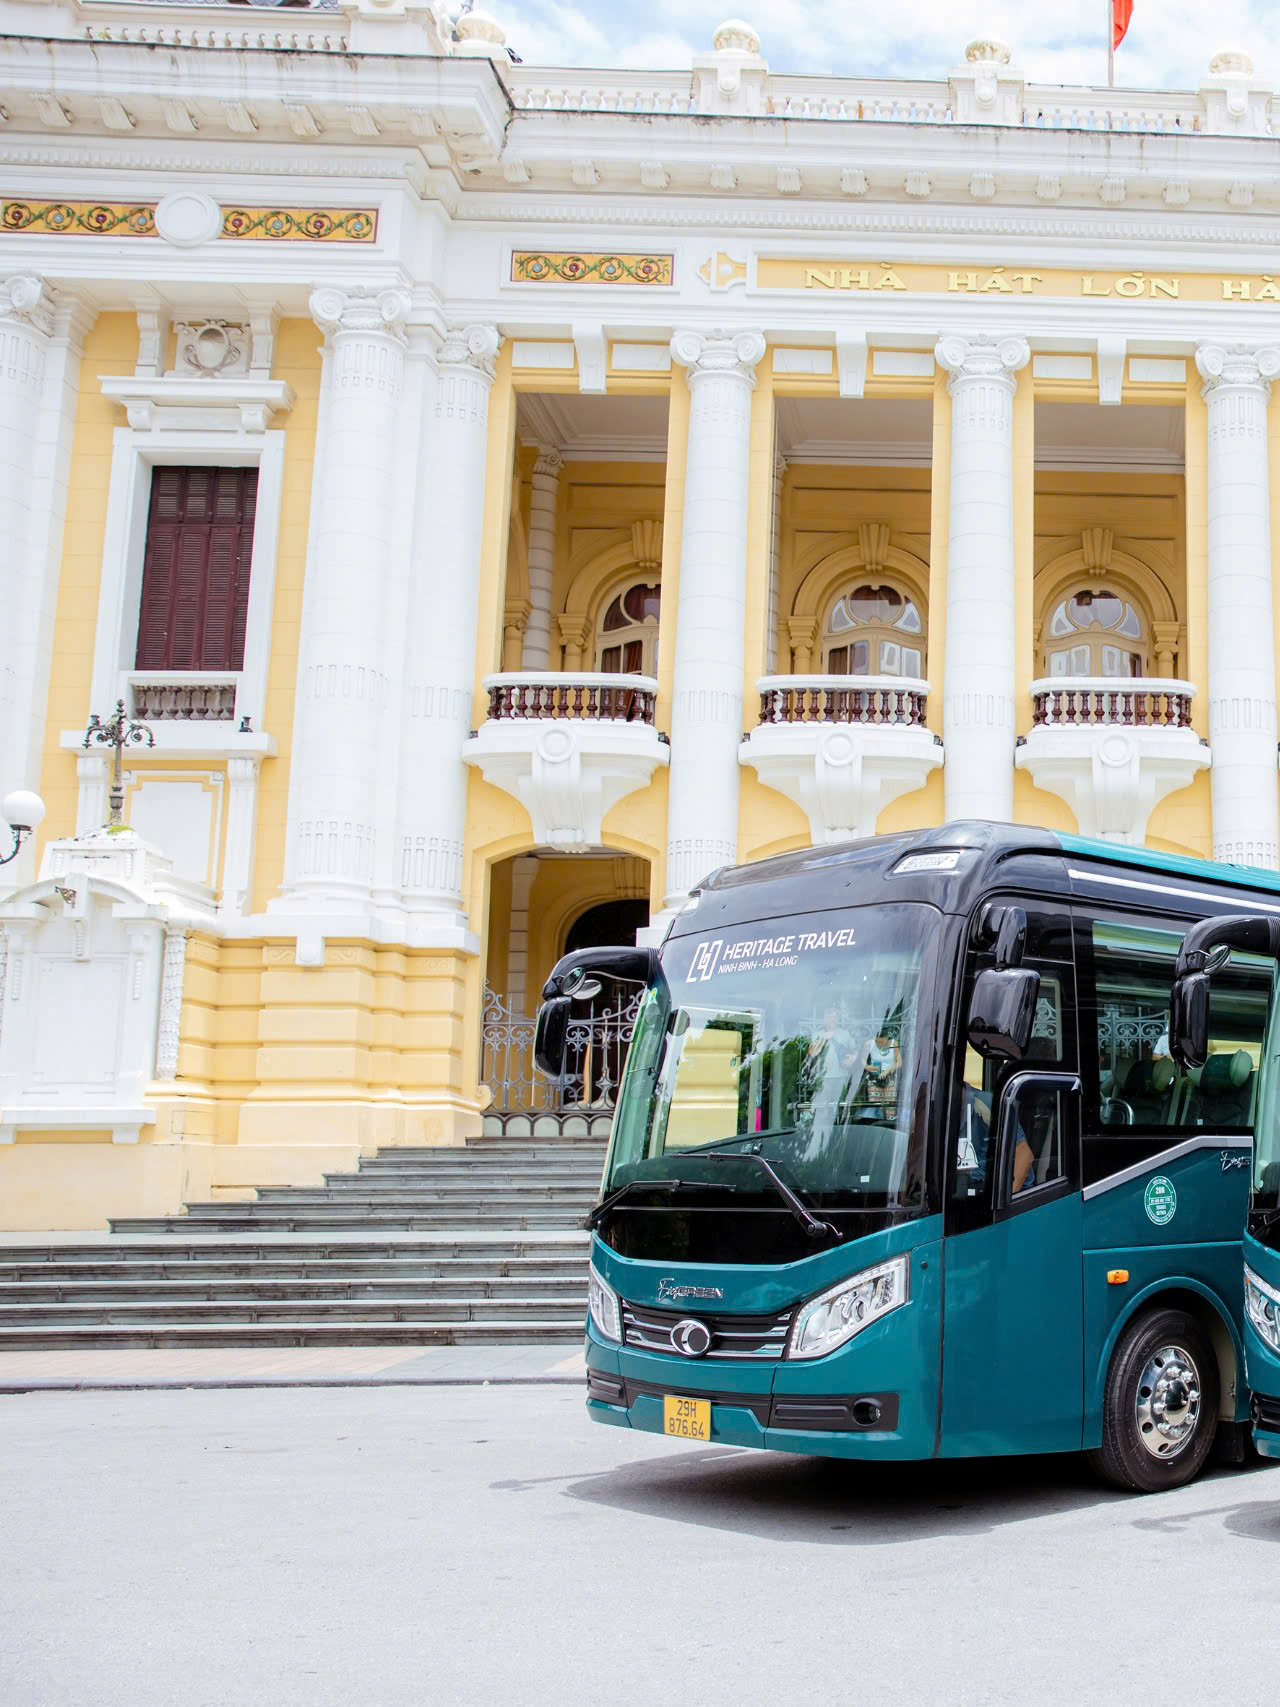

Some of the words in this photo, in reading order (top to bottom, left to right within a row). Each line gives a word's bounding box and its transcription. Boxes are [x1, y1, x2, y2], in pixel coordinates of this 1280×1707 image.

[804, 261, 907, 291] NHÀ
[947, 266, 1043, 294] HÁT
[1081, 271, 1180, 299] LỚN
[722, 935, 796, 961] HERITAGE
[798, 928, 856, 951] TRAVEL
[717, 962, 737, 975] NINH
[737, 960, 757, 972] BINH
[762, 958, 777, 969] HA
[775, 955, 798, 967] LONG
[676, 1399, 697, 1418] 29H
[669, 1417, 705, 1438] 876.64
